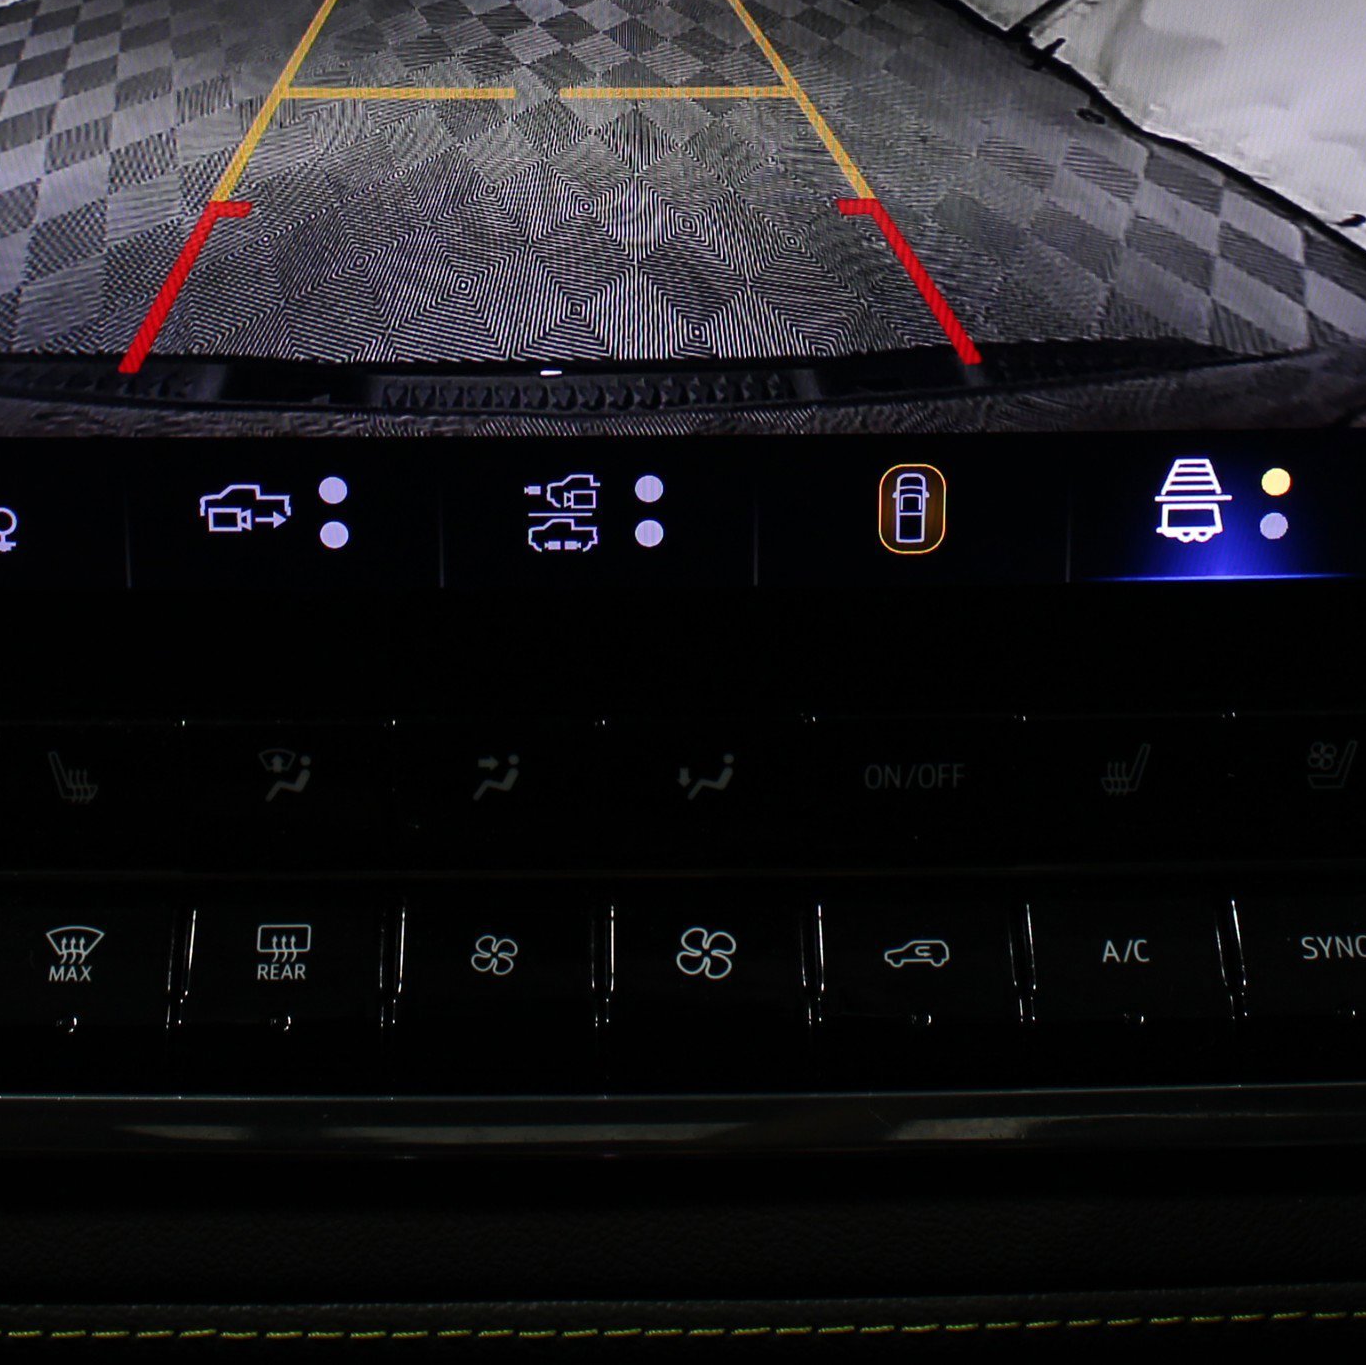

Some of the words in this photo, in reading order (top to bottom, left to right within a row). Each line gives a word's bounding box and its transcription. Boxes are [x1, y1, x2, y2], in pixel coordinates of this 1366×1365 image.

[863, 762, 967, 791] ON/OFF
[1101, 938, 1150, 964] A/C
[48, 965, 92, 983] MAX
[256, 964, 306, 981] REAR
